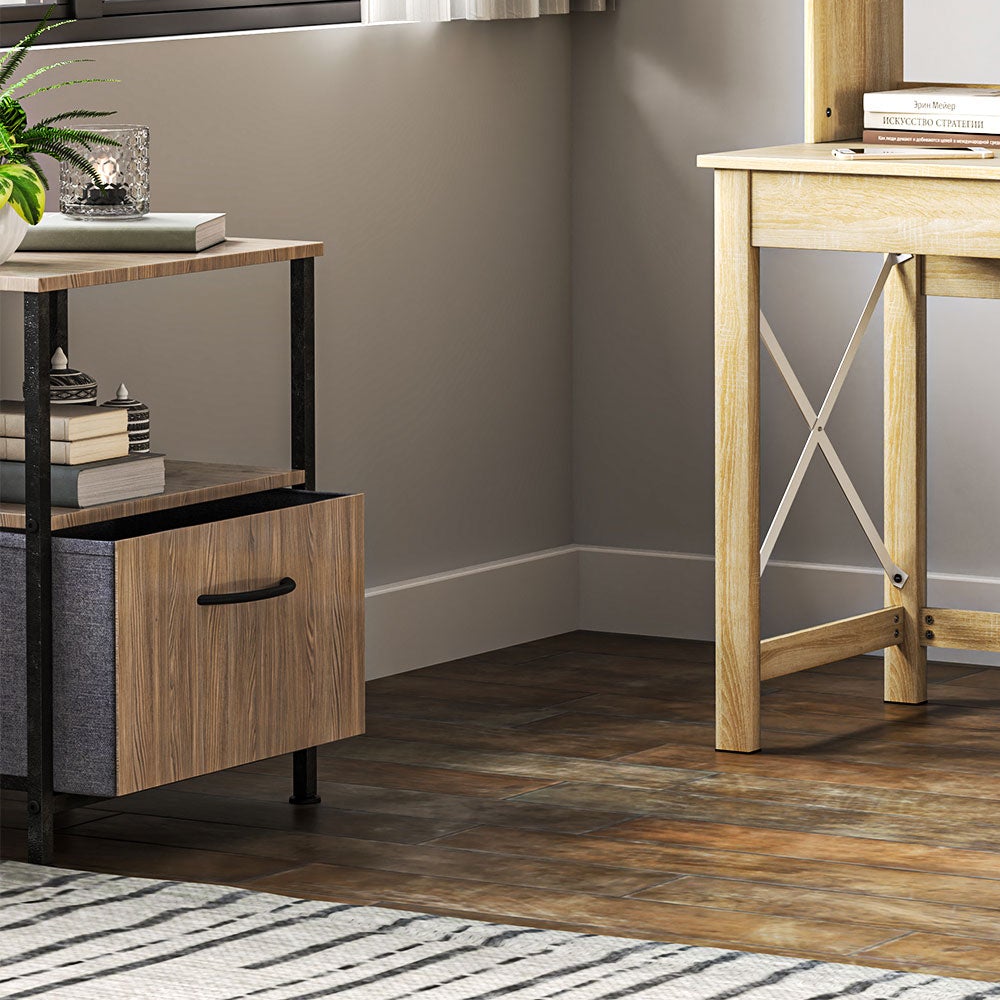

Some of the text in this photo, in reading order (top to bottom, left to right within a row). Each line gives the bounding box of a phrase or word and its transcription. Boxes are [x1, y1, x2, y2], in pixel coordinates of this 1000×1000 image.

[913, 100, 931, 110] Эрин
[882, 116, 984, 129] ИСКУССТВО СТРАТЕГИИ
